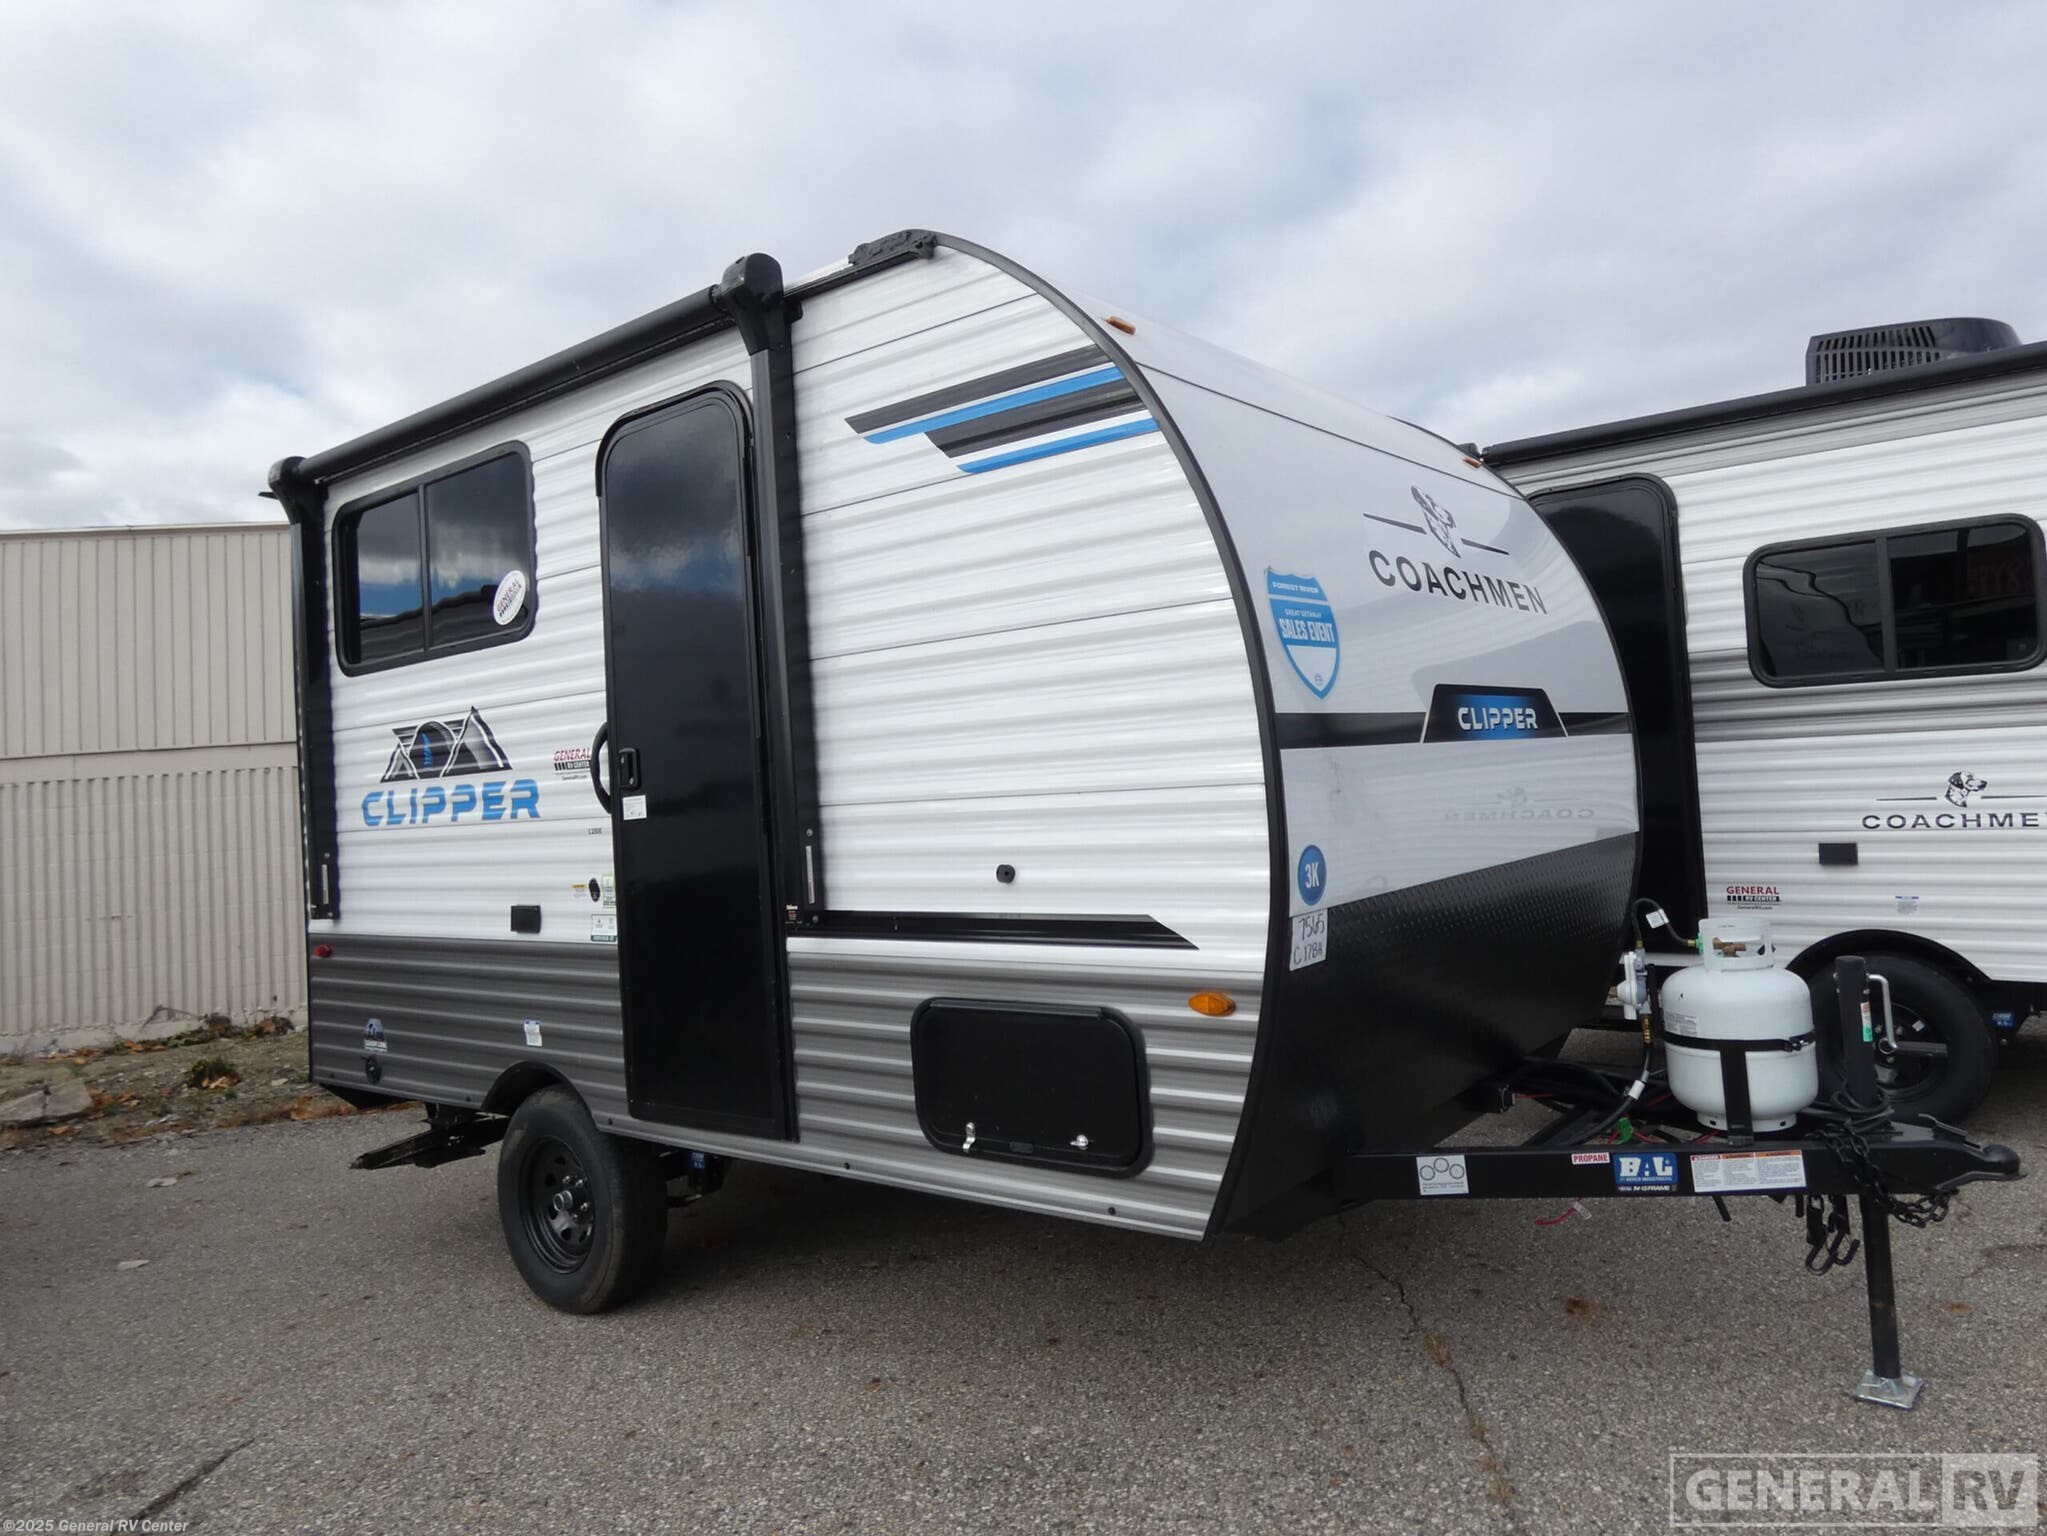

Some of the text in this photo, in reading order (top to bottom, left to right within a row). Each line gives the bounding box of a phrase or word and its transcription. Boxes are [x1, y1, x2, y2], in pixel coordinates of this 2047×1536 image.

[1272, 581, 1320, 594] FOREST RIVER
[1368, 549, 1549, 616] COACHMEN
[1279, 617, 1336, 643] SALES EVENT
[1457, 706, 1539, 731] CLIPPER
[554, 748, 591, 762] GENERAL
[361, 778, 541, 827] CLIPPER
[1862, 812, 2047, 829] COACHME
[1304, 862, 1320, 889] 3K
[1726, 885, 1780, 895] GENERAL
[1572, 1153, 1609, 1163] PROPANE
